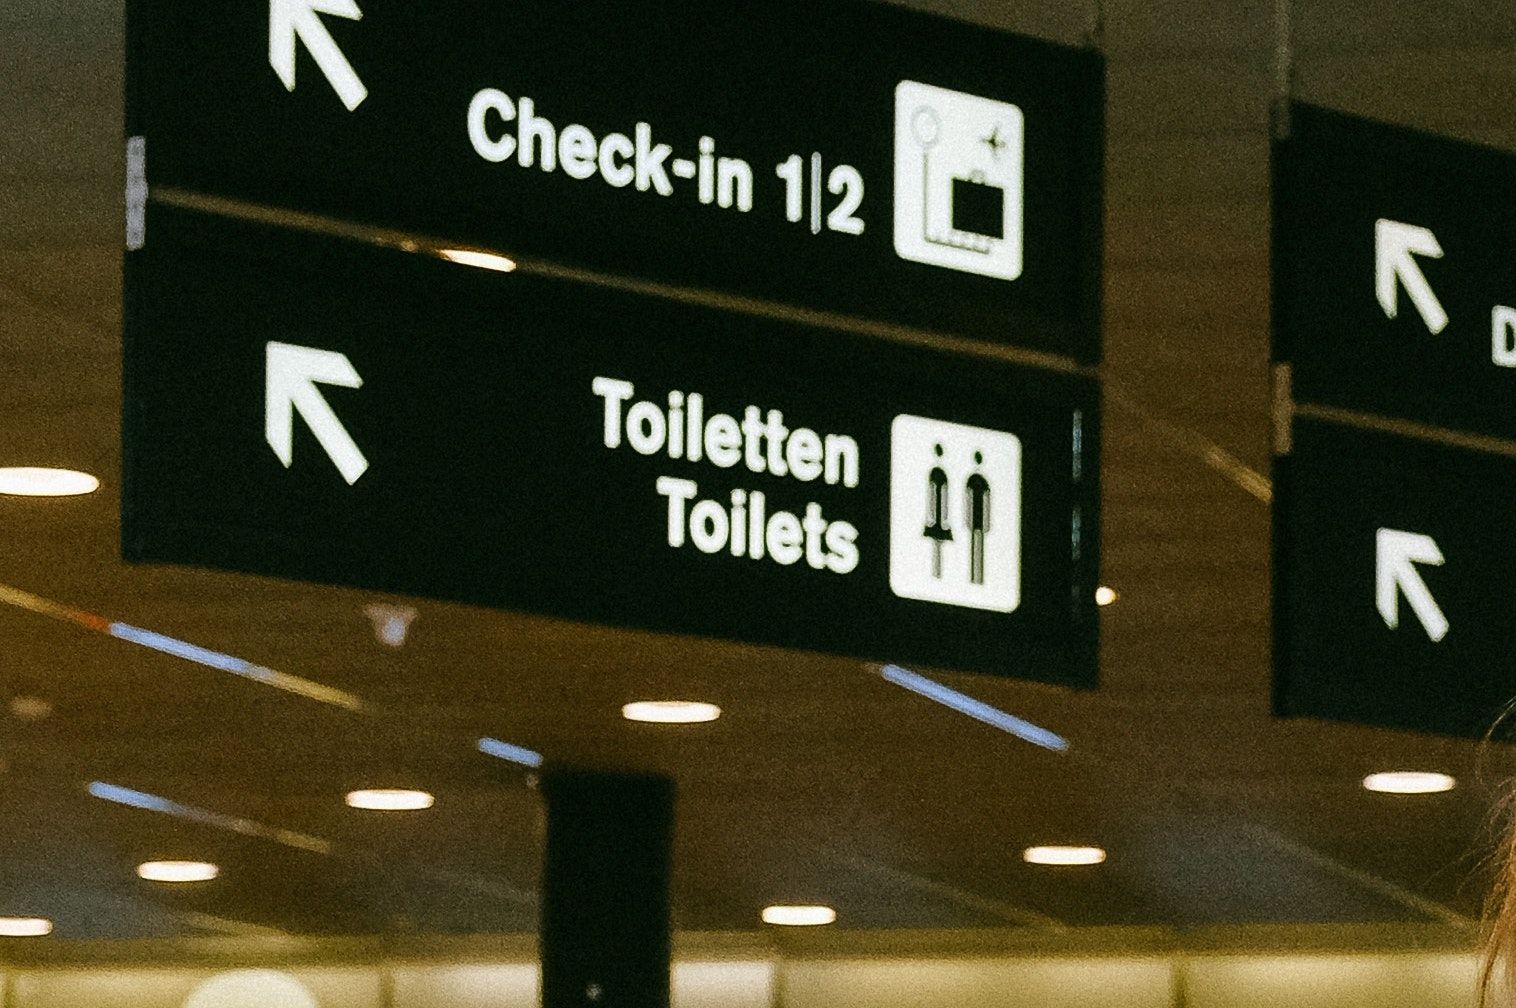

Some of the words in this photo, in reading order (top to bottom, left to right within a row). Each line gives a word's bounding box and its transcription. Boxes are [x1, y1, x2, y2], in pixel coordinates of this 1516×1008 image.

[466, 87, 754, 214] Check-in
[591, 375, 861, 489] Toiletten
[655, 475, 861, 575] Toilets
